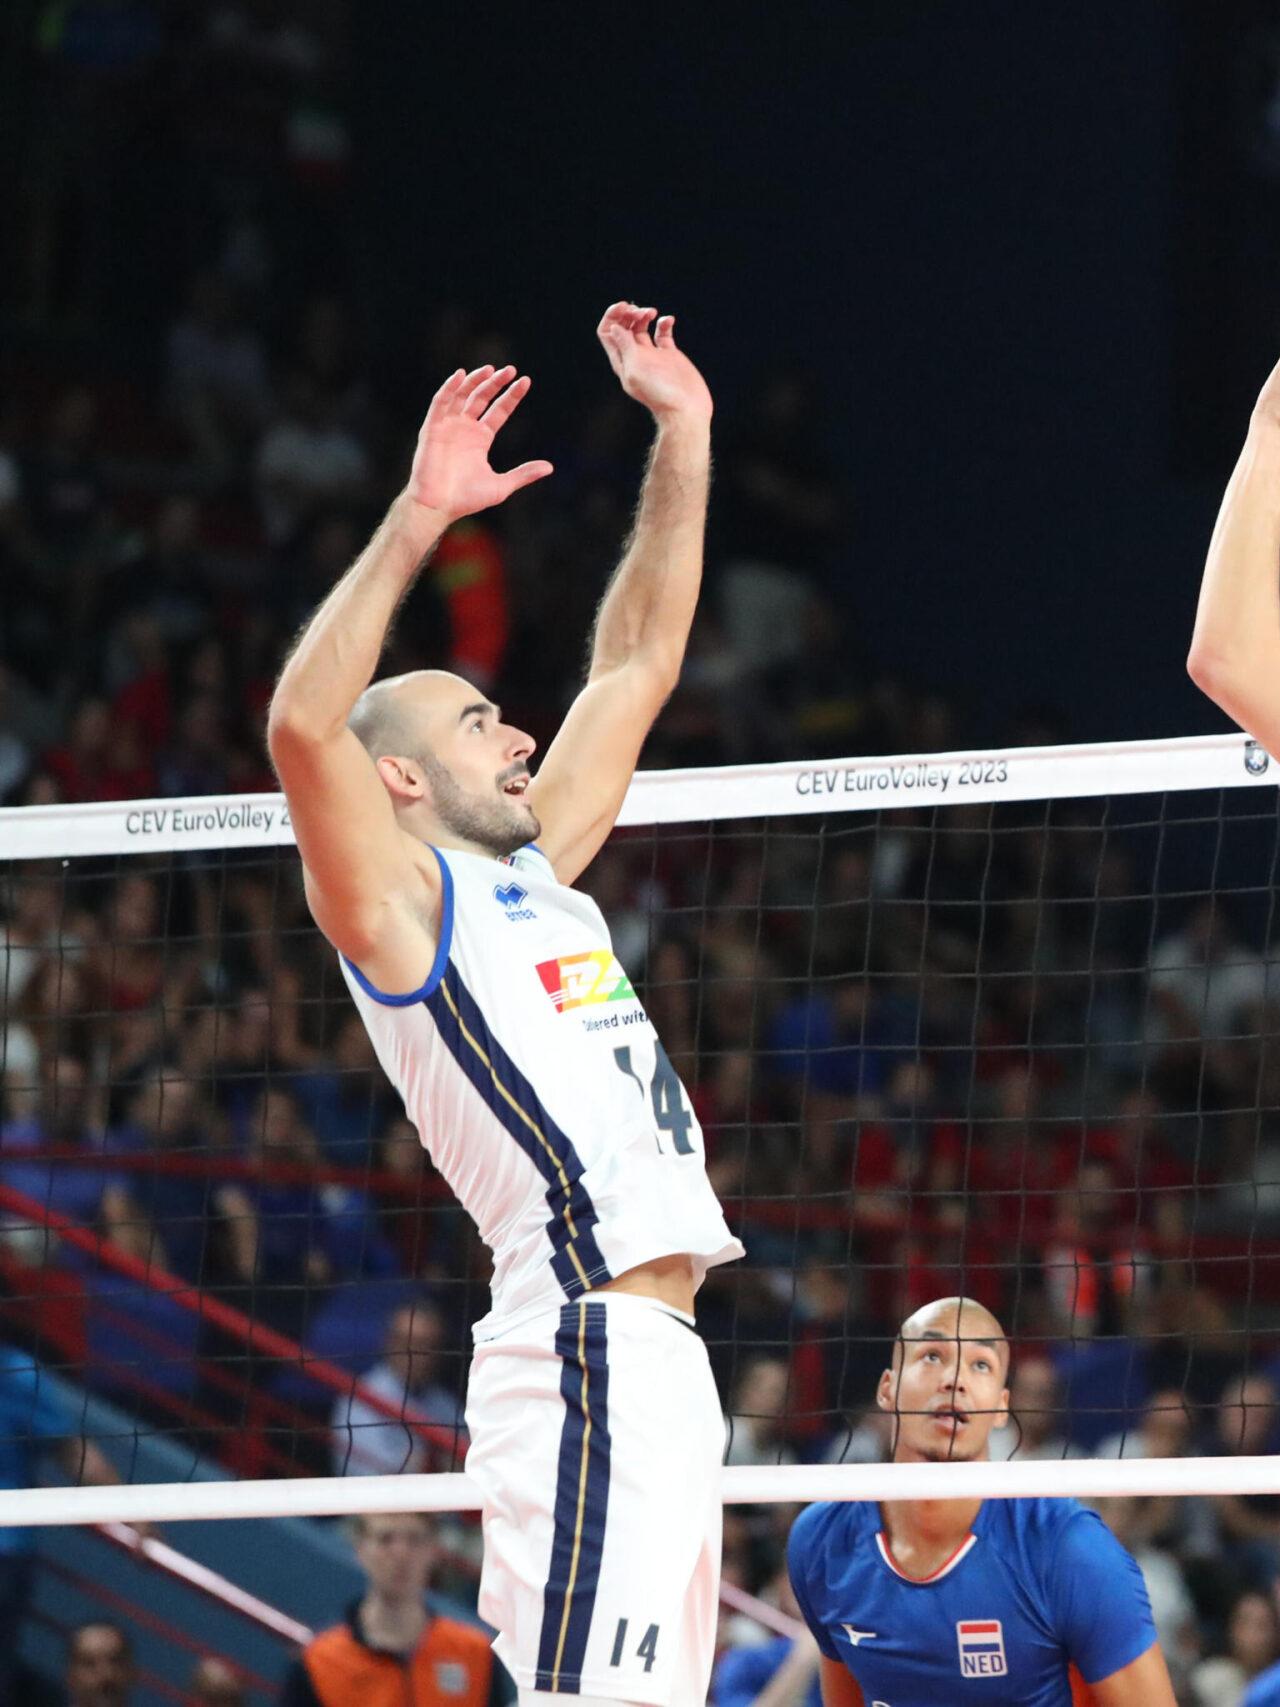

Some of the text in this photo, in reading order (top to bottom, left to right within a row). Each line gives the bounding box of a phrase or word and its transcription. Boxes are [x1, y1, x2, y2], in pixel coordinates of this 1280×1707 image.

[796, 760, 1008, 795] CEV EuroVolley 2023
[126, 810, 166, 835] CEV
[171, 804, 275, 832] EuroVolley
[609, 1617, 660, 1673] 14
[963, 1654, 1003, 1675] NED
